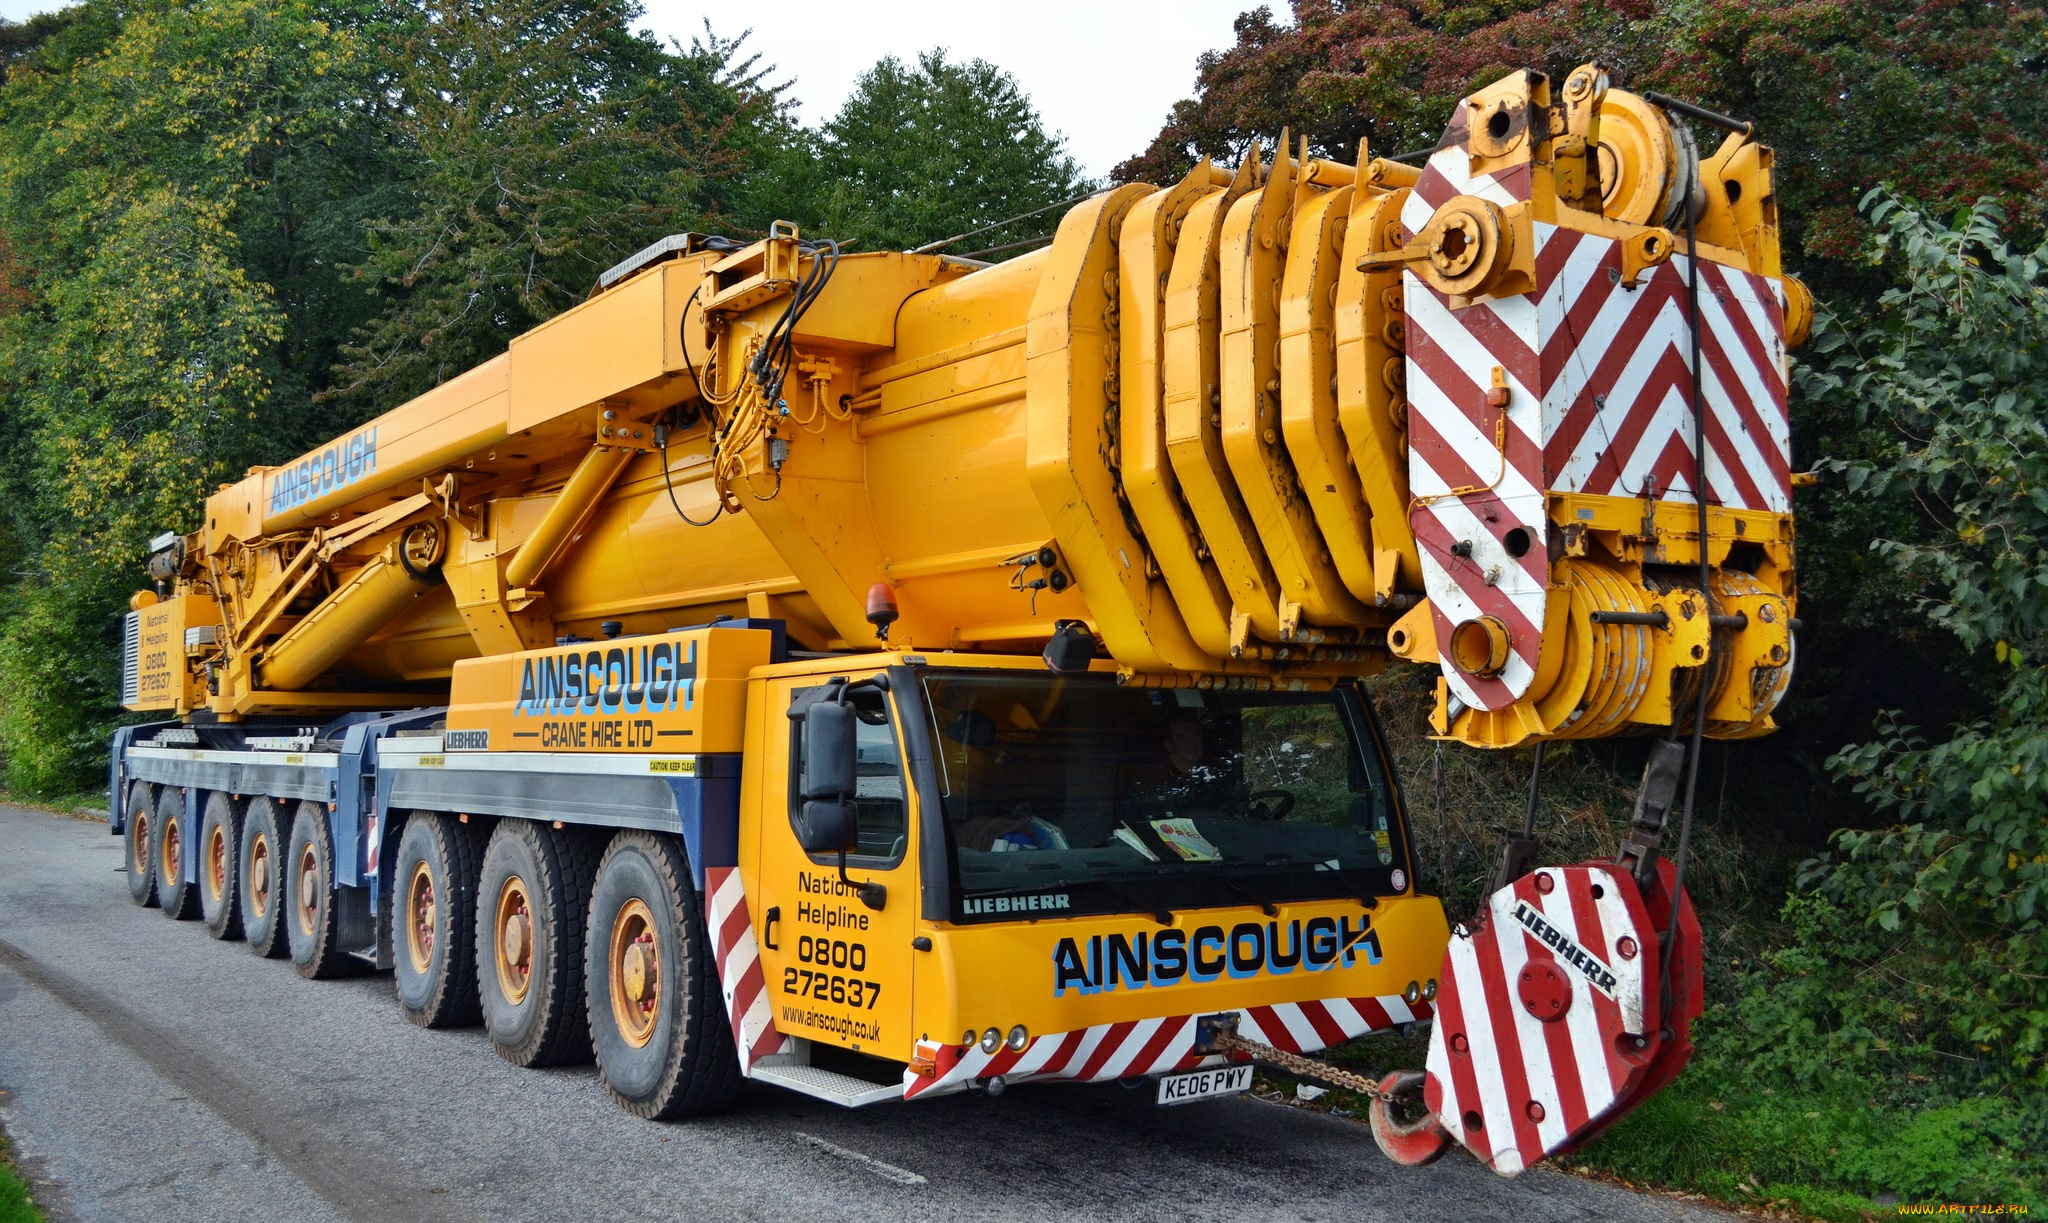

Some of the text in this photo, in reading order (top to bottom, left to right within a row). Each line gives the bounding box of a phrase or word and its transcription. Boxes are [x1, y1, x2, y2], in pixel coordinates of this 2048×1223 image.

[269, 425, 377, 517] AINSCOUGH
[147, 610, 169, 627] National
[146, 632, 168, 647] Helpline
[146, 651, 167, 670] 0800
[142, 672, 171, 691] 272637
[513, 639, 698, 717] AINSCOUGH
[446, 731, 488, 749] LIEBHERR
[542, 719, 653, 748] CRANE HIRE LTD
[669, 761, 680, 771] KEEP
[798, 901, 869, 931] Helpline
[963, 894, 1070, 914] LIEBHERR
[798, 935, 866, 972] 0800
[1053, 914, 1383, 997] AINSCOUGH
[1515, 903, 1617, 994] LIEBHERR
[784, 967, 881, 1010] 272637
[782, 1005, 881, 1042] www.ainscough.co.uk
[1165, 1068, 1246, 1099] KE06 PWY
